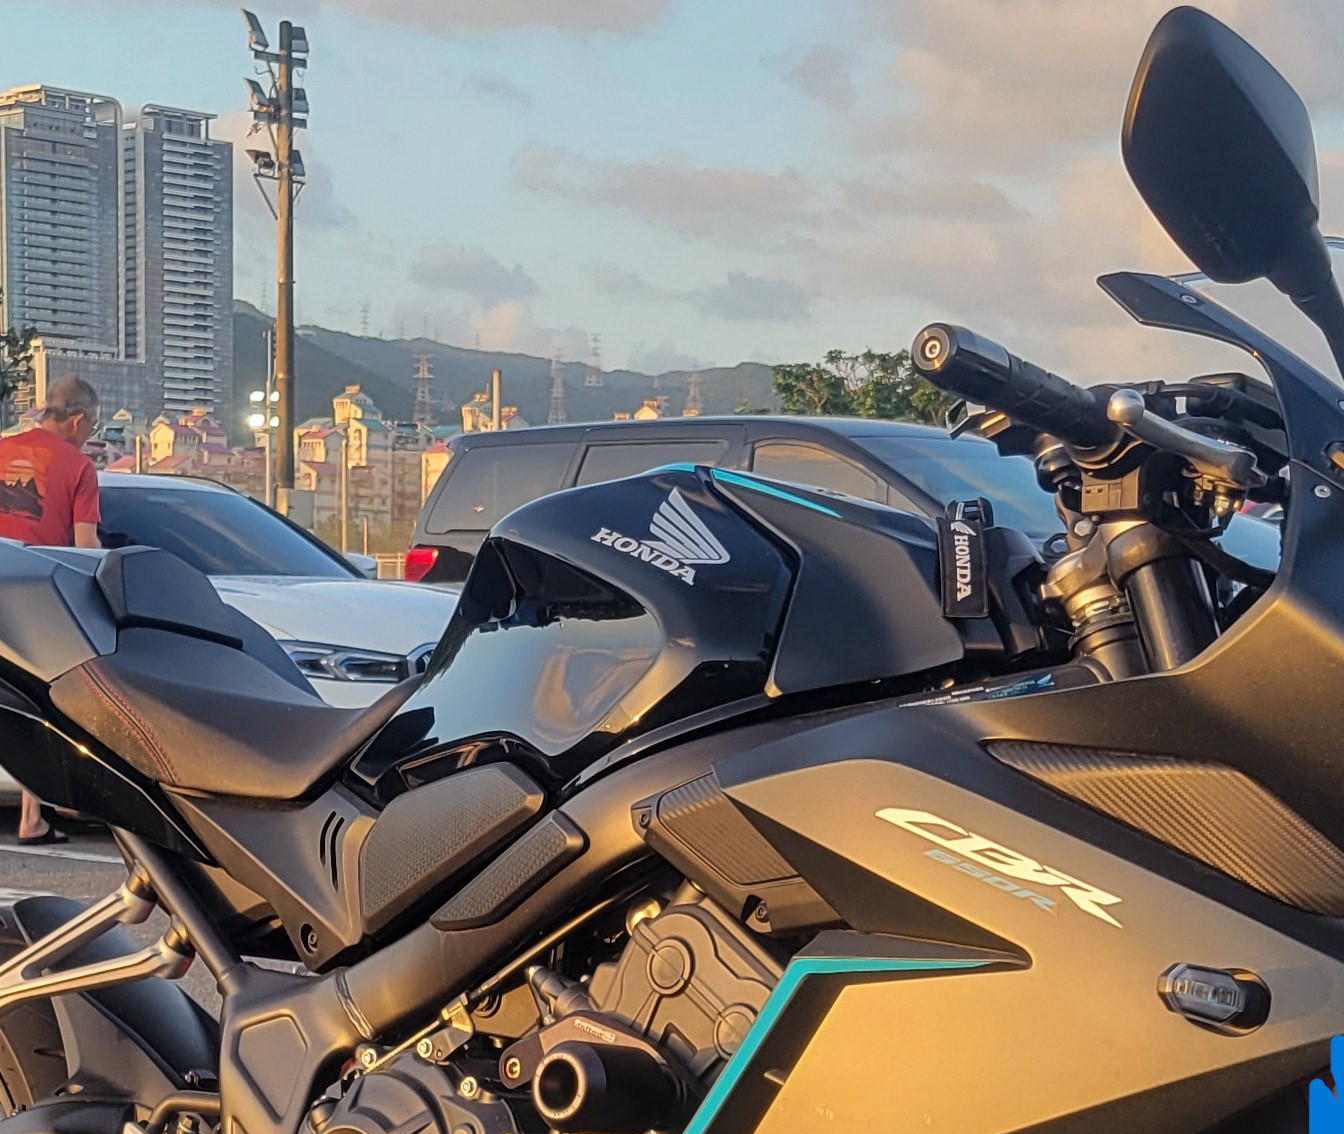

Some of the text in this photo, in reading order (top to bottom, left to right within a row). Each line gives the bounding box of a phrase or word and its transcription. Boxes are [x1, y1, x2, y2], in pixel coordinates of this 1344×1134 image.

[590, 526, 696, 587] HONDA
[953, 534, 973, 601] HONDA
[874, 807, 1124, 929] CBR
[922, 848, 1059, 915] 650R
